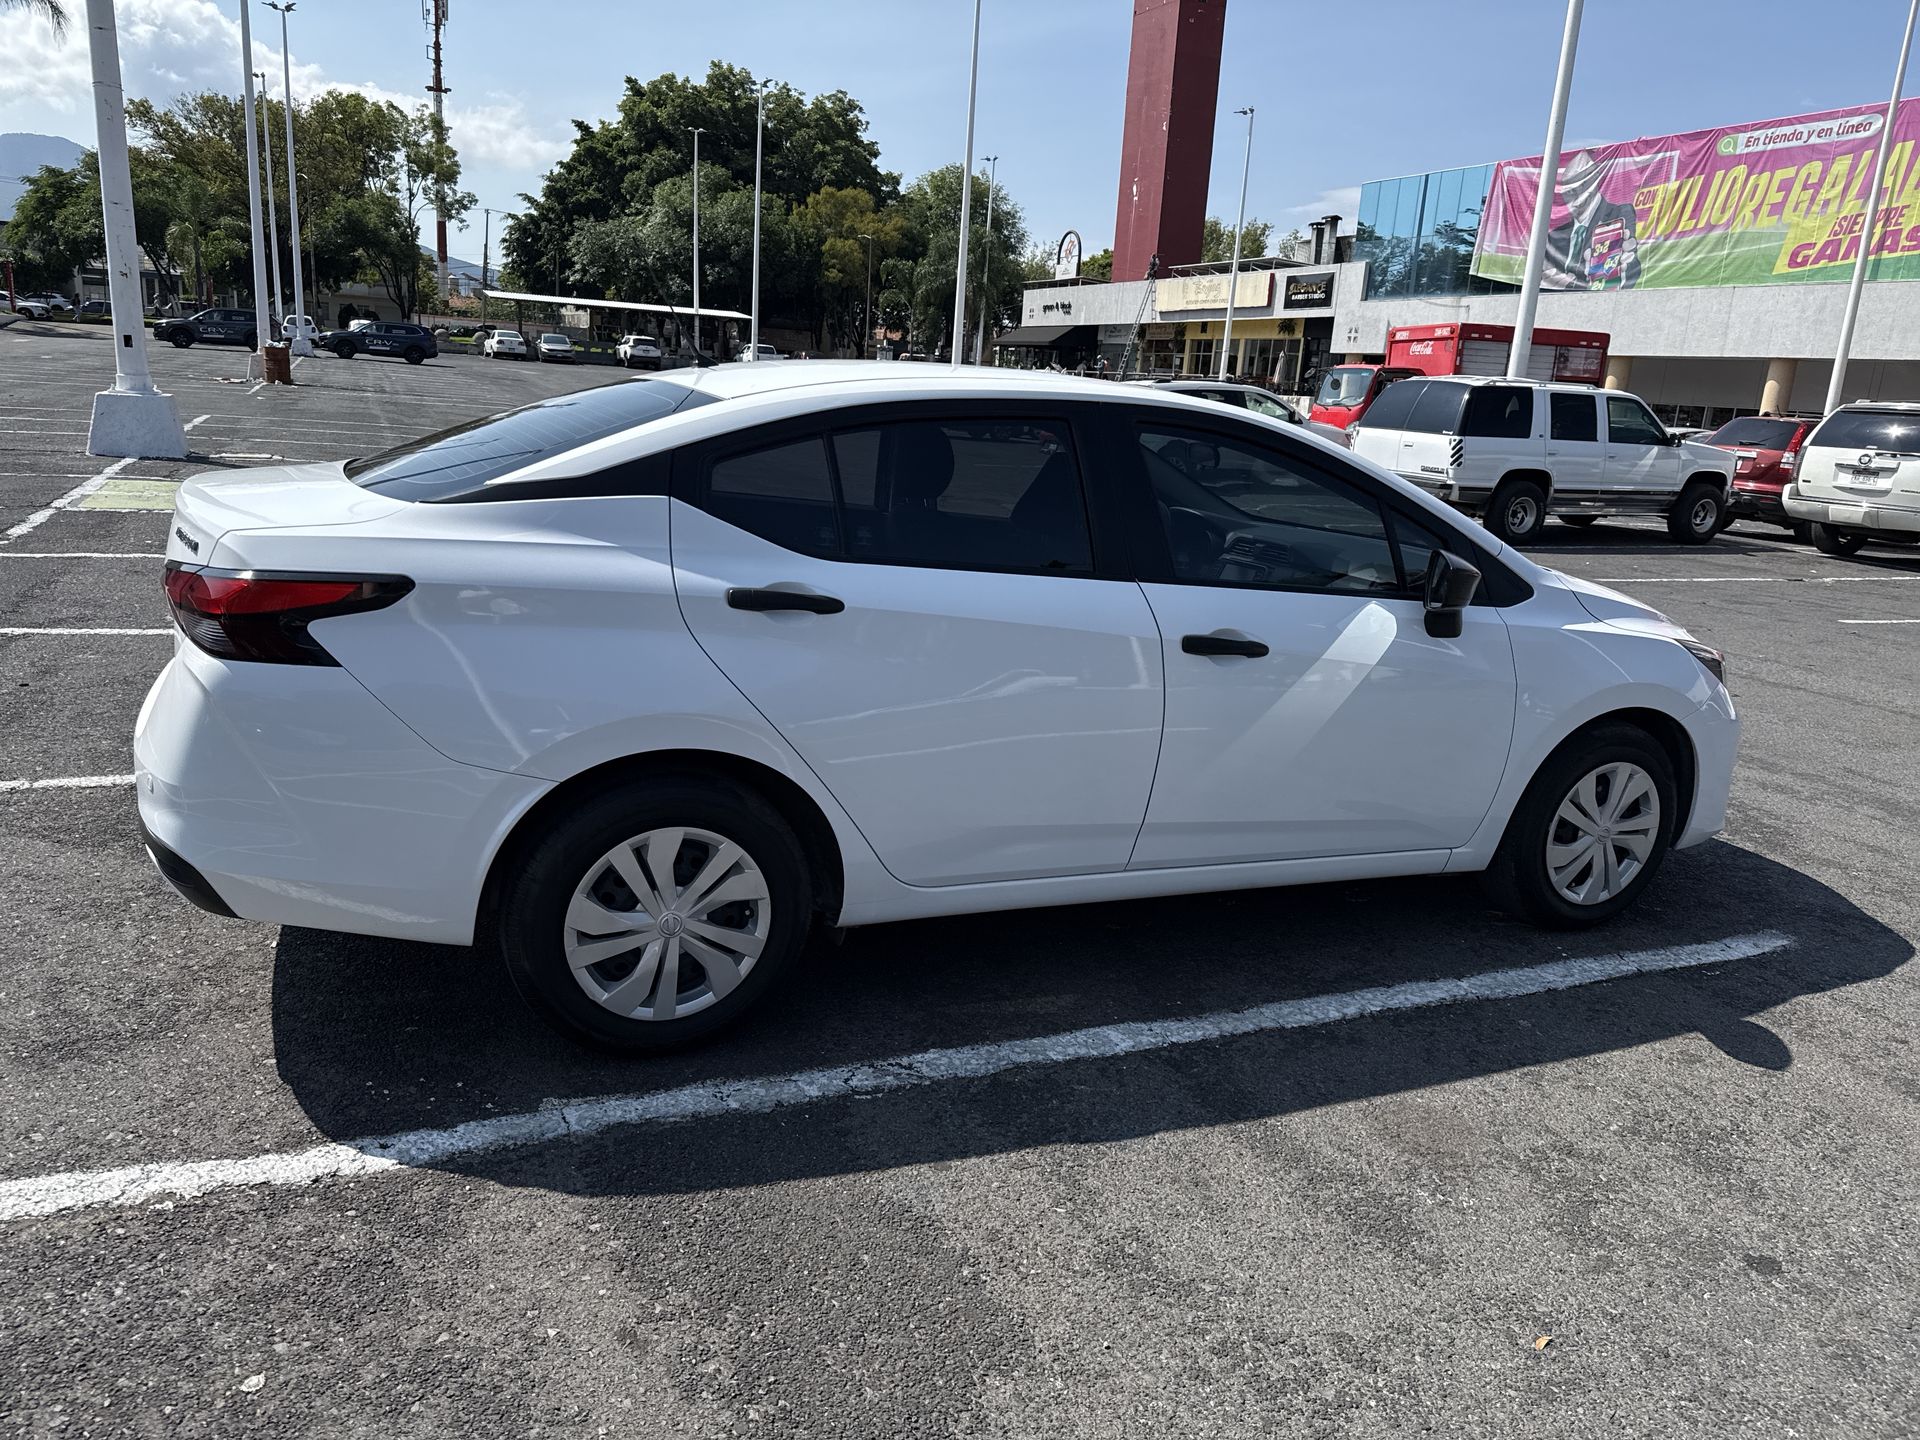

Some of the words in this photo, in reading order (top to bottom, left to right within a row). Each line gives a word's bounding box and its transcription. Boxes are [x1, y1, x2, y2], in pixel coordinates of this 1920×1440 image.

[1744, 135, 1760, 149] En
[1762, 129, 1803, 146] tienda
[1803, 129, 1816, 143] y
[1817, 125, 1833, 139] en
[1836, 120, 1873, 137] línea
[1635, 187, 1659, 207] CON
[1309, 292, 1326, 300] STUDIO
[200, 326, 228, 334] CR-V
[365, 338, 393, 346] CR-V
